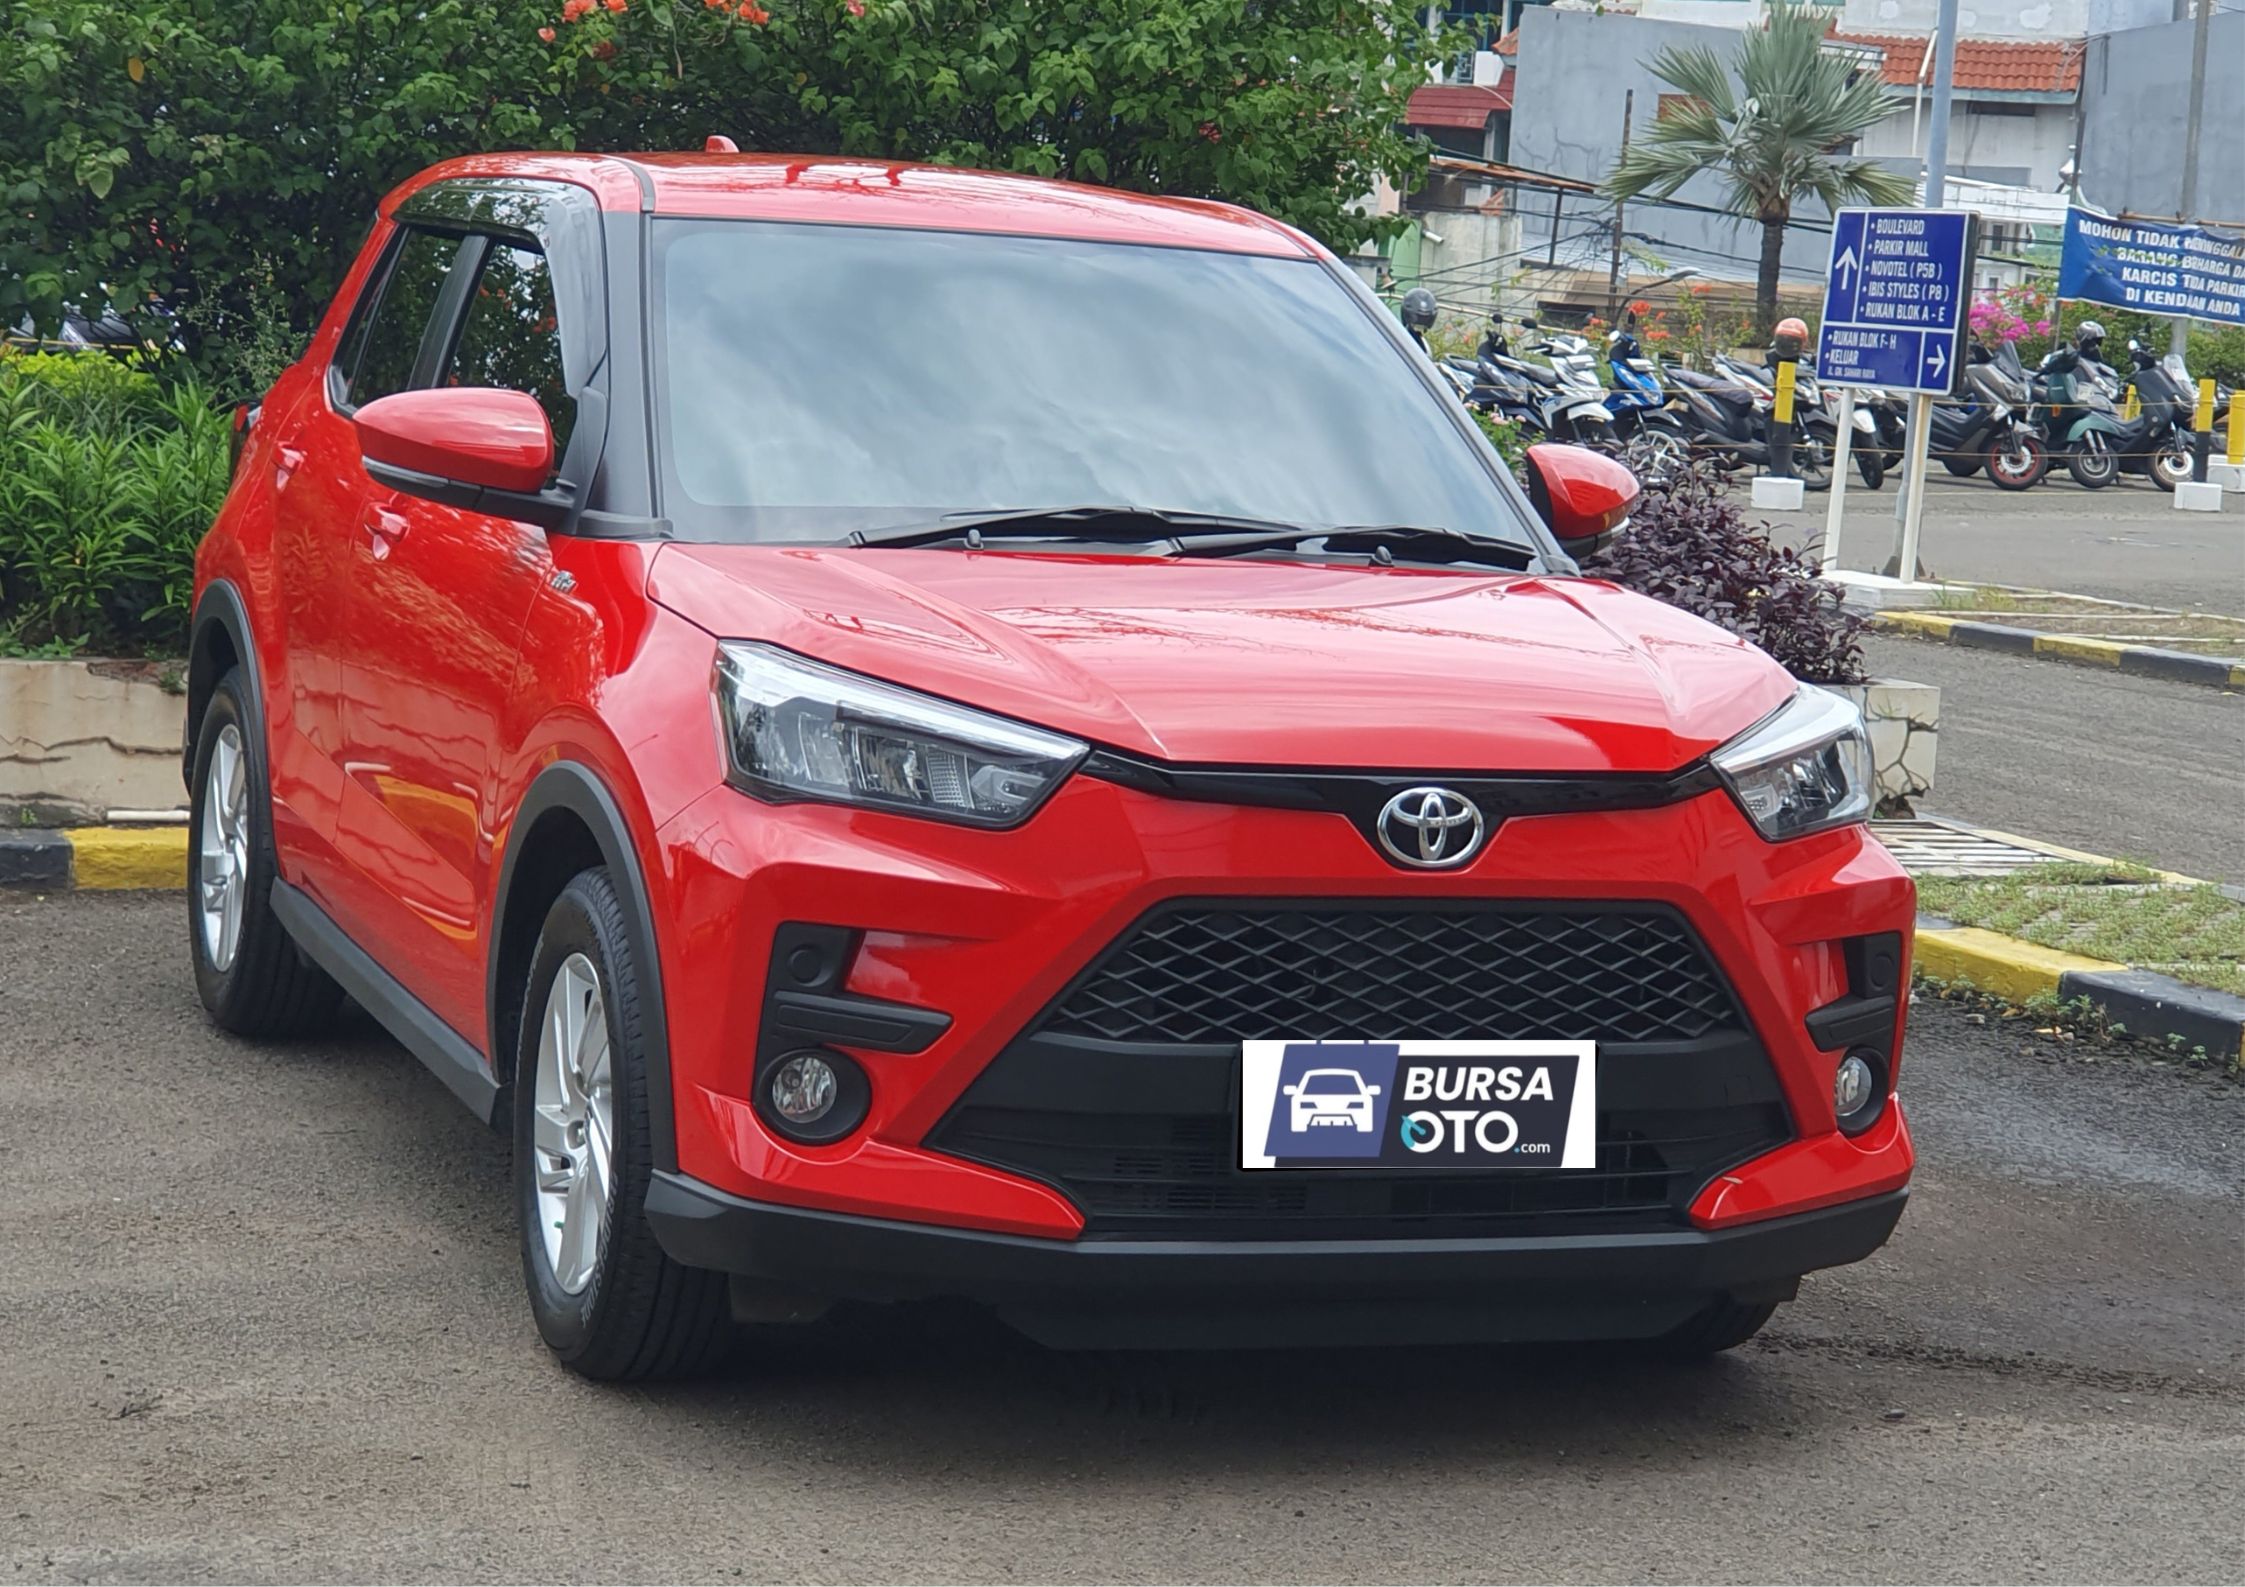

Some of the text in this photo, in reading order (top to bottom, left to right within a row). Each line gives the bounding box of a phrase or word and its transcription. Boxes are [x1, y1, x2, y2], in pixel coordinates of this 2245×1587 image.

[1876, 218, 1925, 235] BOULEVARD
[2079, 219, 2132, 243] MOHON
[2136, 230, 2181, 250] TIDAK
[1873, 239, 1929, 257] PARKIR MALL
[1870, 260, 1908, 277] NOVOTEL
[2121, 266, 2178, 288] KARCIS
[1867, 283, 1885, 298] IBIS
[1886, 284, 1920, 301] STYLES
[2125, 286, 2140, 303] DI
[2207, 299, 2241, 317] ANDA
[1865, 301, 1895, 320] RUKAN
[1896, 302, 1920, 321] BLOK
[1832, 330, 1859, 346] RUKAN
[1859, 331, 1879, 348] BLOK
[1829, 349, 1859, 366] KELUAR
